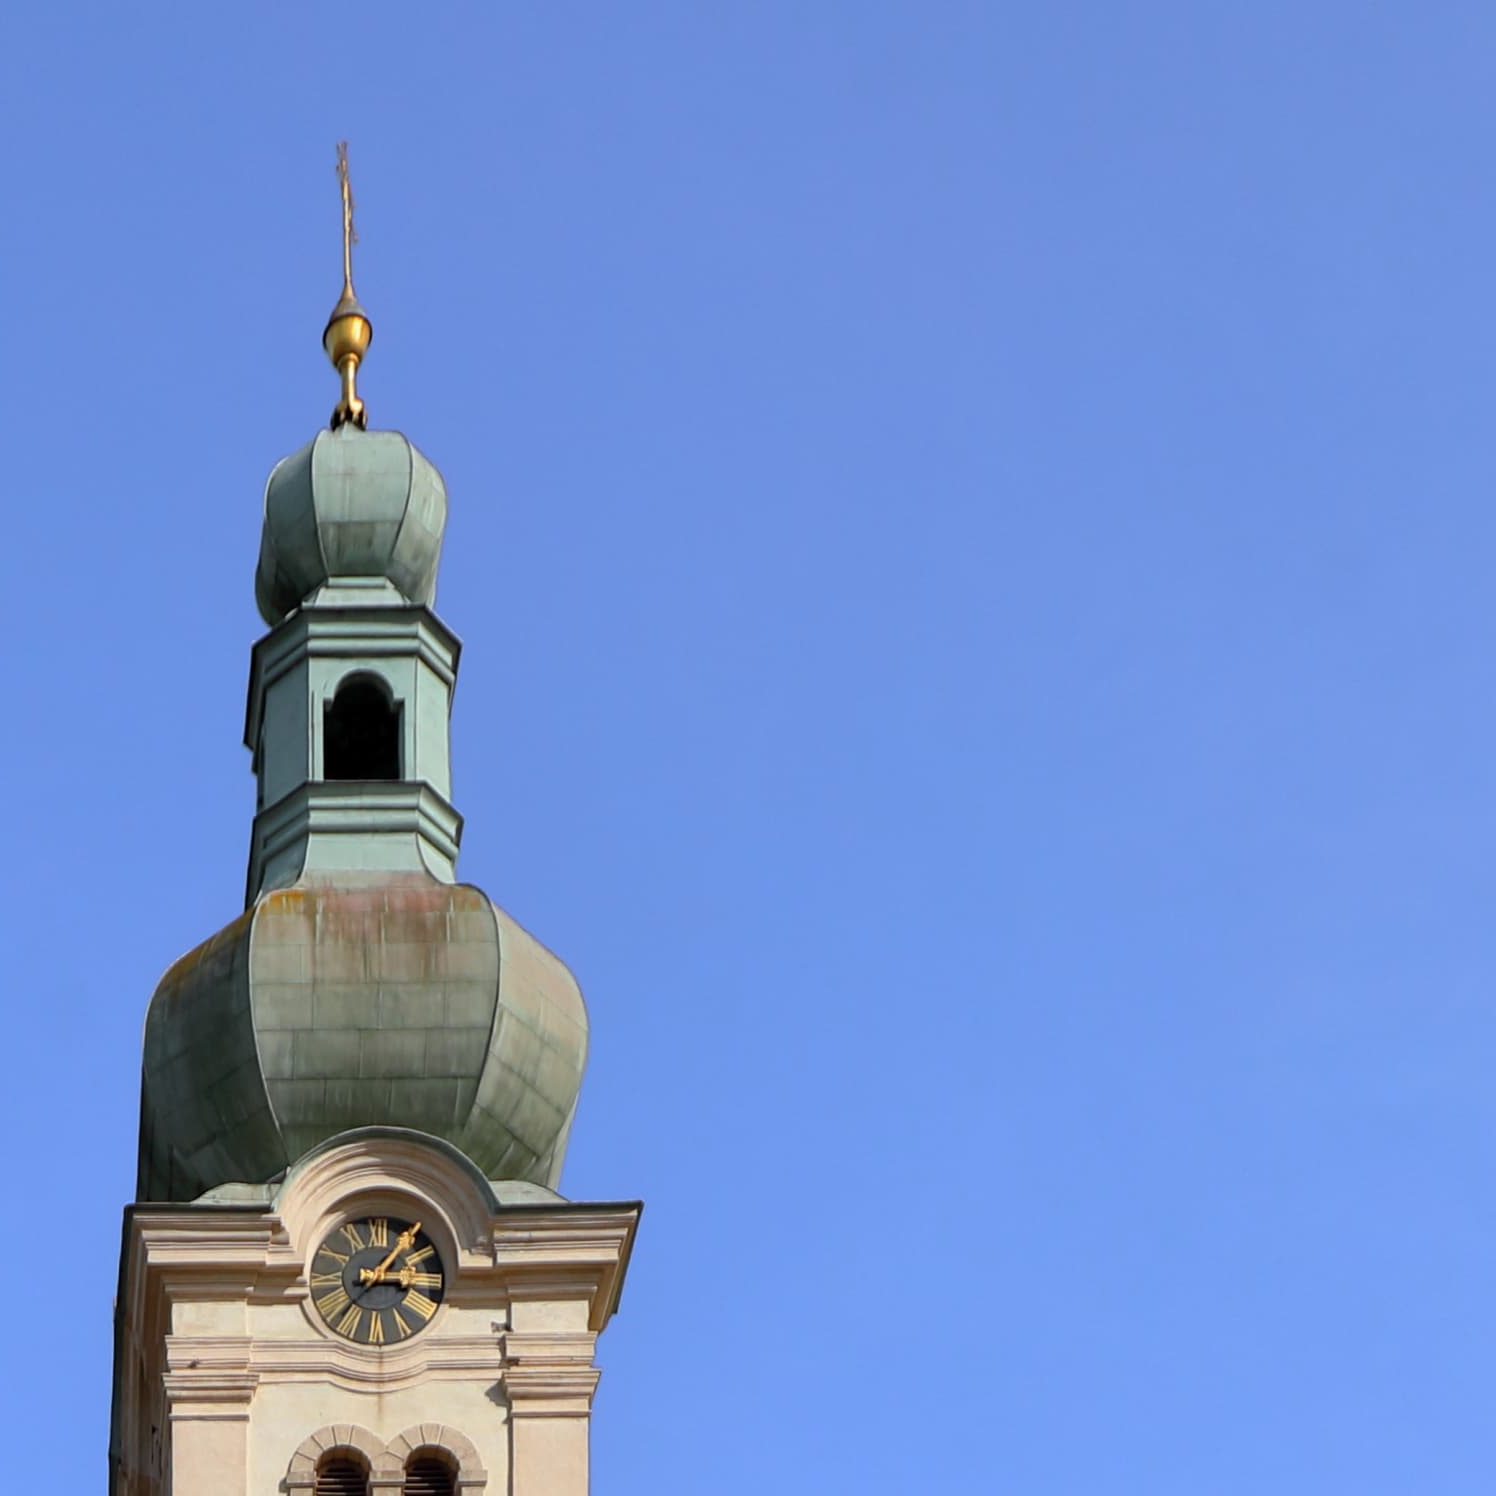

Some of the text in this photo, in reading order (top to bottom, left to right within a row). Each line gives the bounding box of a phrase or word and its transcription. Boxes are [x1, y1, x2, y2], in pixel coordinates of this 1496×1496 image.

[340, 1223, 365, 1254] XI
[367, 1219, 388, 1248] XII
[318, 1243, 350, 1266] X
[311, 1271, 343, 1287] IX
[368, 1311, 384, 1342] VI
[393, 1307, 412, 1339] V
